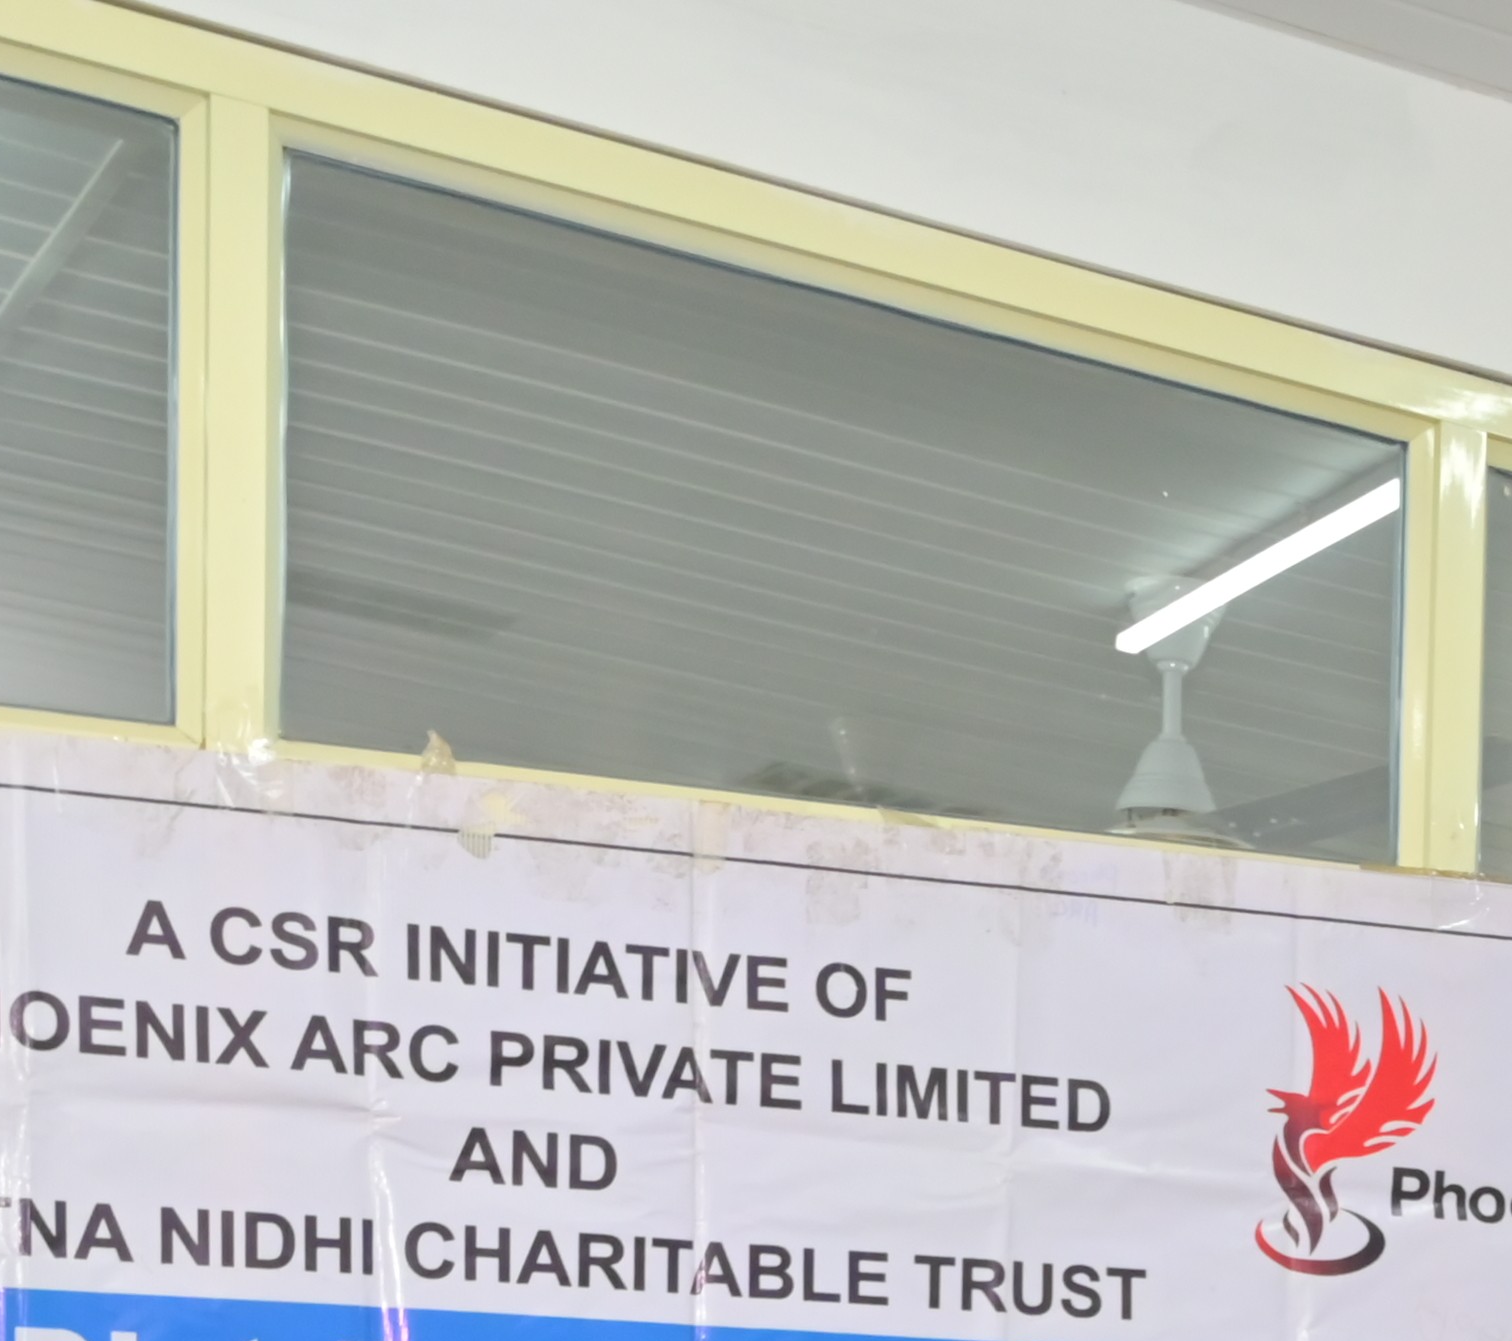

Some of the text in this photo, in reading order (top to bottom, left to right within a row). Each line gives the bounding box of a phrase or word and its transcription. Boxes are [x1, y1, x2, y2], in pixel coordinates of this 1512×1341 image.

[127, 901, 910, 1020] A CSR INITIATIVE OF
[291, 1016, 458, 1082] ARC
[490, 1023, 802, 1110] PRIVATE
[832, 1060, 1110, 1131] LIMITED
[450, 1128, 616, 1190] AND
[162, 1208, 372, 1274] NIDHI
[405, 1222, 889, 1308] CHARITABLE
[915, 1255, 1146, 1319] TRUST
